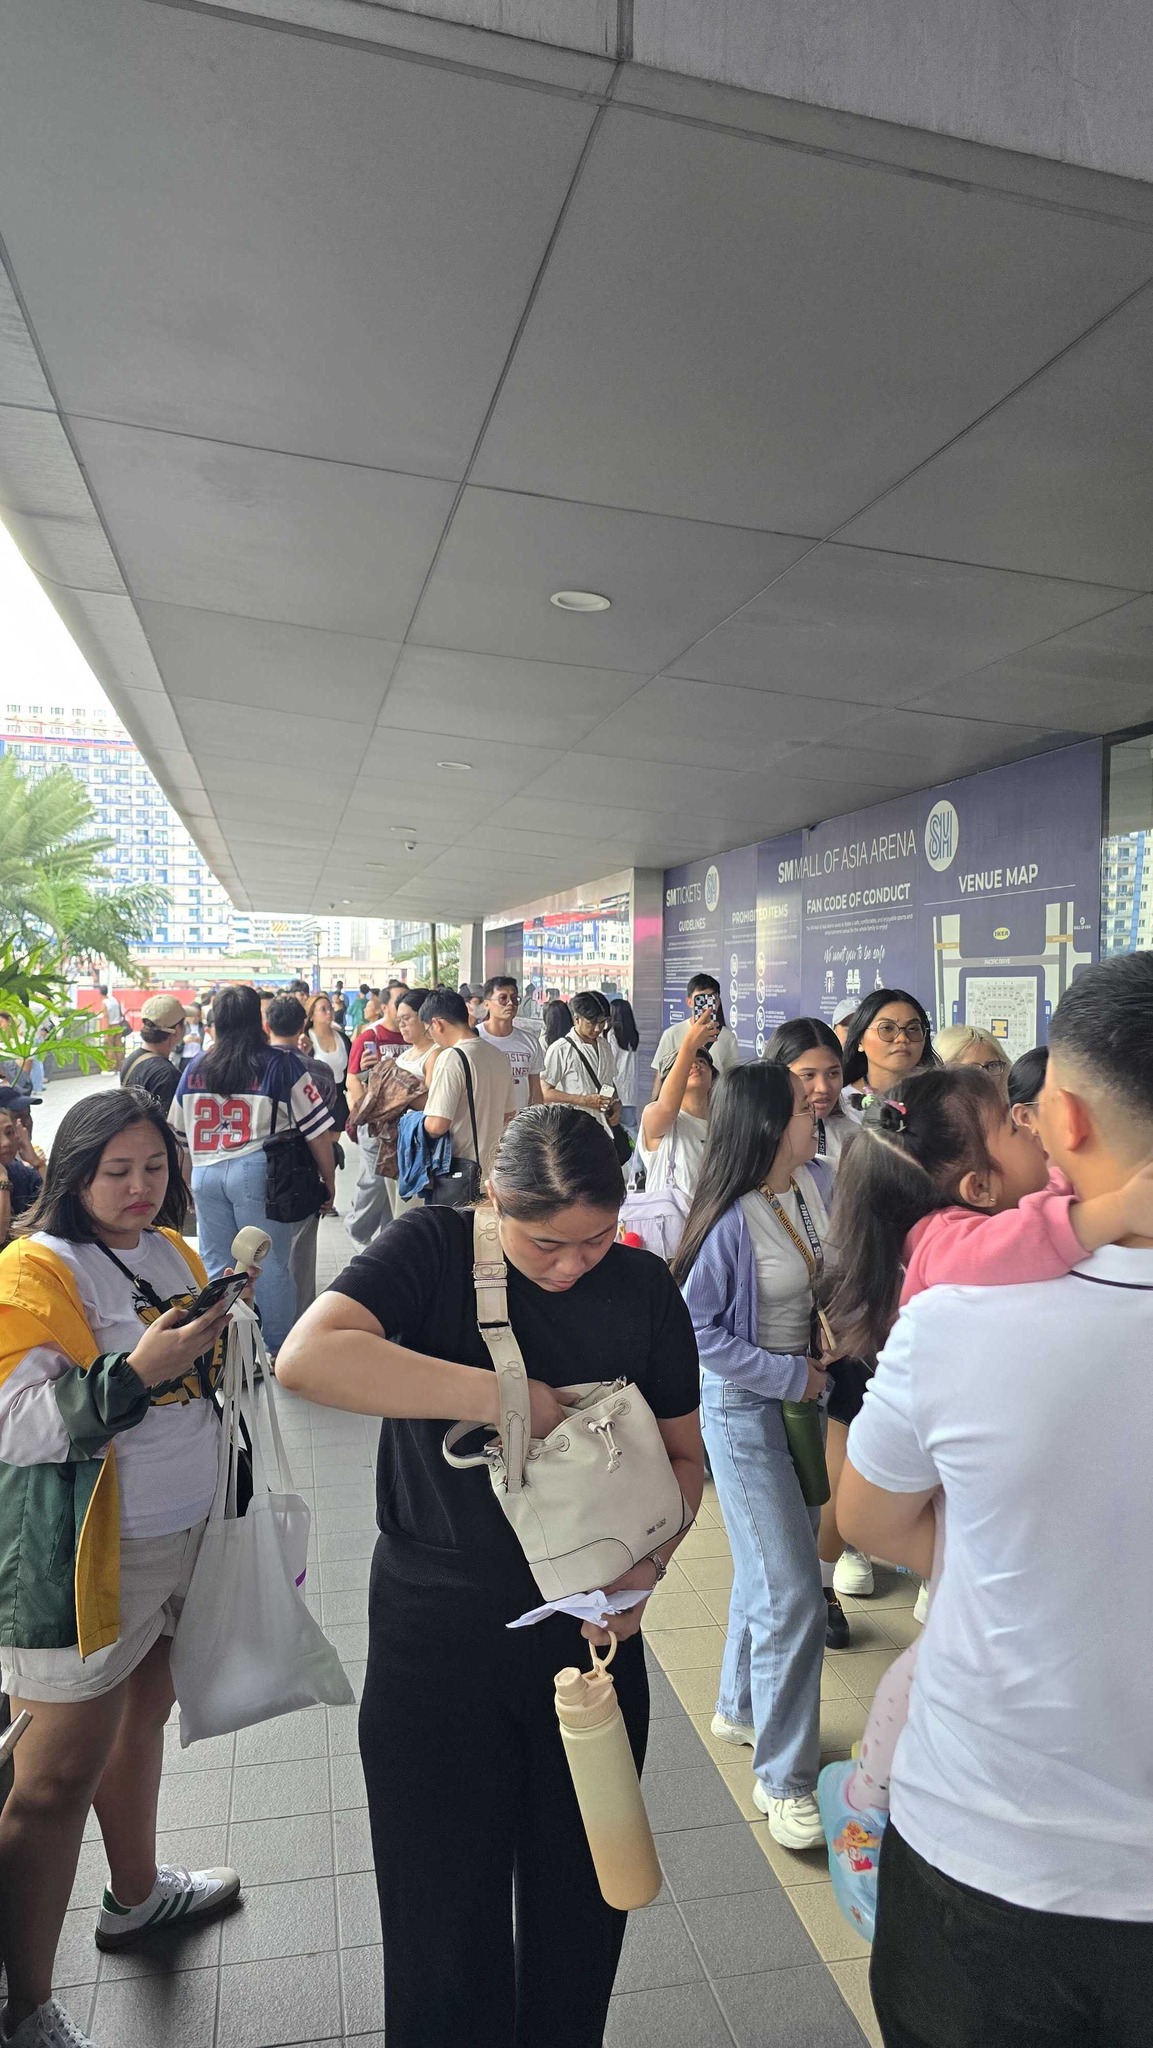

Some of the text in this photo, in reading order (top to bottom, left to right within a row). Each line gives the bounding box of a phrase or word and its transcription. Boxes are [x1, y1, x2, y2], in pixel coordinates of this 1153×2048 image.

[823, 848, 840, 874] OF
[841, 841, 868, 871] ASIA
[869, 829, 917, 865] ARENA
[958, 863, 1039, 893] VENUE MAP
[732, 904, 788, 925] PROHIBITED ITEMS
[806, 883, 911, 915] FAN CODE OF CONDUCT
[678, 917, 706, 932] GUIDELINES
[193, 1097, 252, 1155] 23
[777, 1209, 798, 1240] National
[800, 1204, 819, 1245] NURSING
